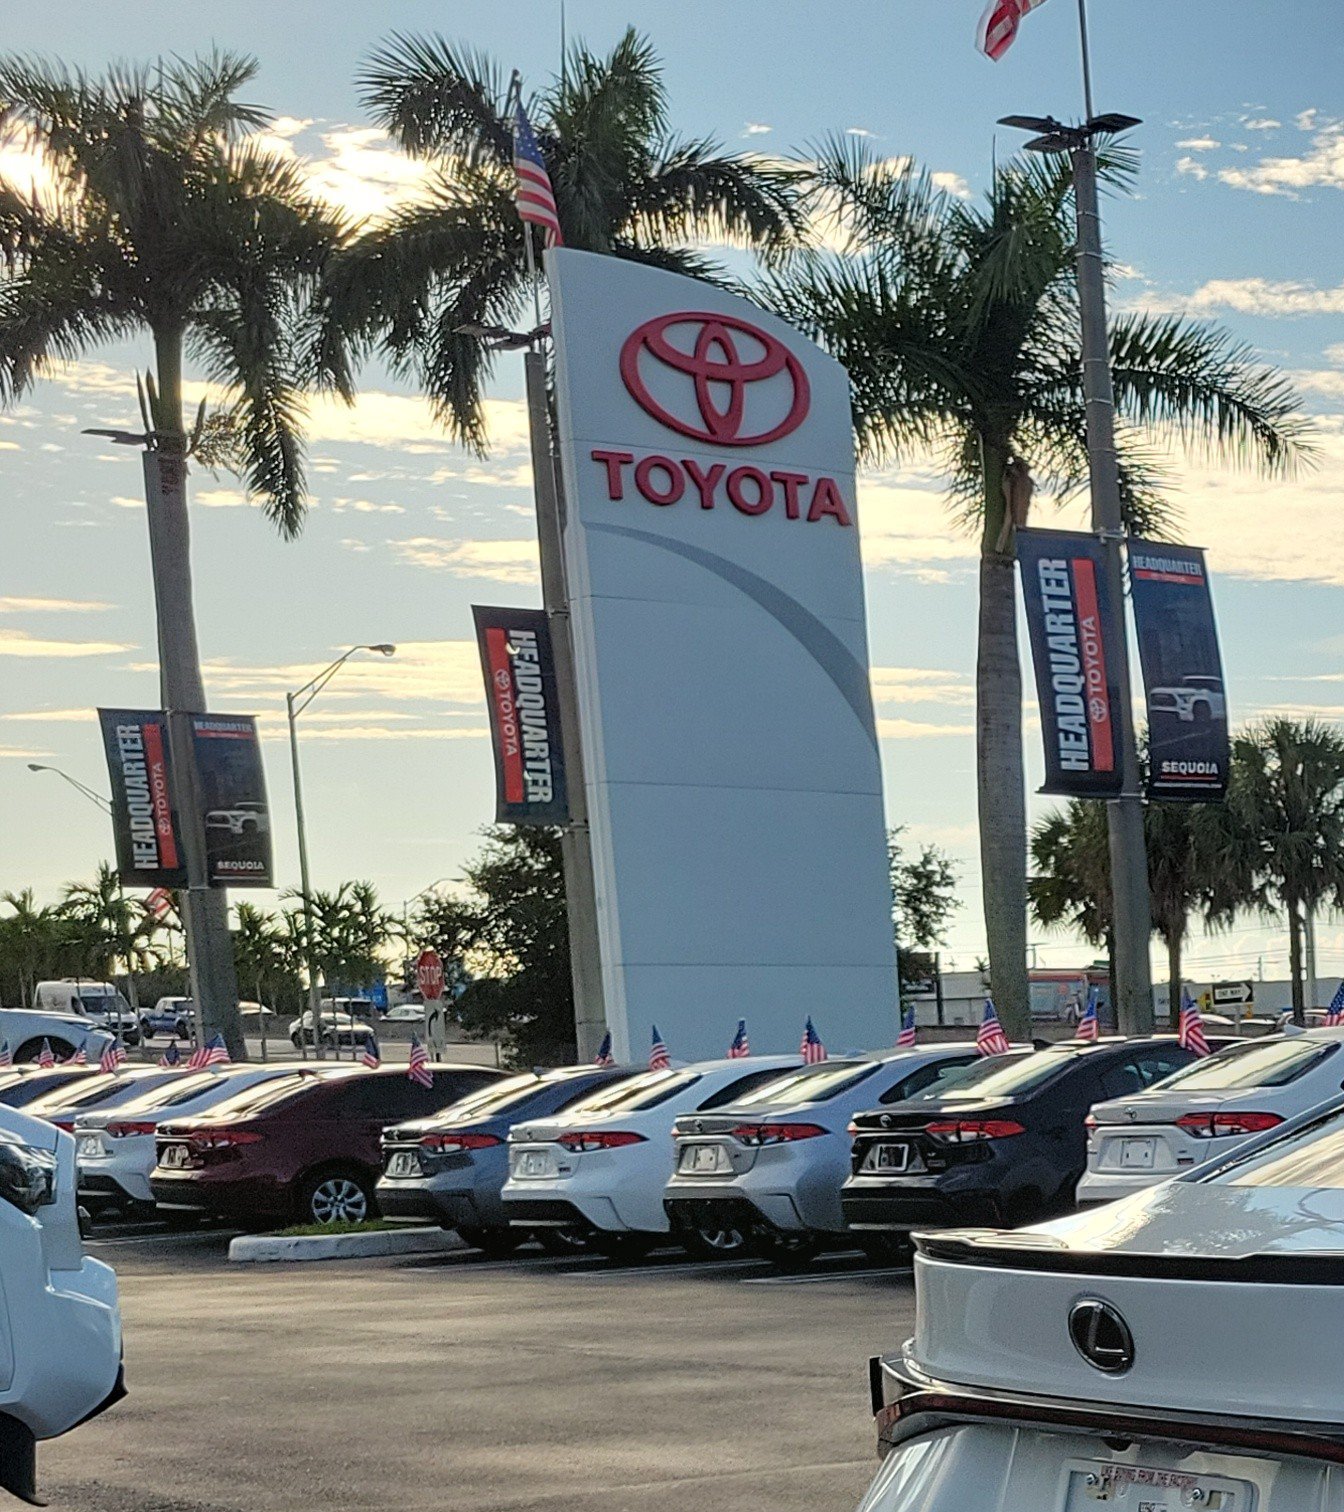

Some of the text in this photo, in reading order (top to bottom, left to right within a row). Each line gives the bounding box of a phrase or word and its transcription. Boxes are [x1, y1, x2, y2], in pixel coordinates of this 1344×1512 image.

[591, 450, 853, 526] TOYOTA
[1038, 558, 1089, 771] HEADQUARTER
[1081, 616, 1108, 695] TOYOTA
[500, 690, 518, 756] TOYOTA
[509, 630, 553, 803] HEADQUARTER
[116, 724, 159, 869] HEADQUARTER
[153, 762, 170, 819] TOYOTA
[1161, 761, 1218, 775] SEQUOIA
[217, 860, 264, 870] SEQUOIA
[420, 967, 443, 985] STOP
